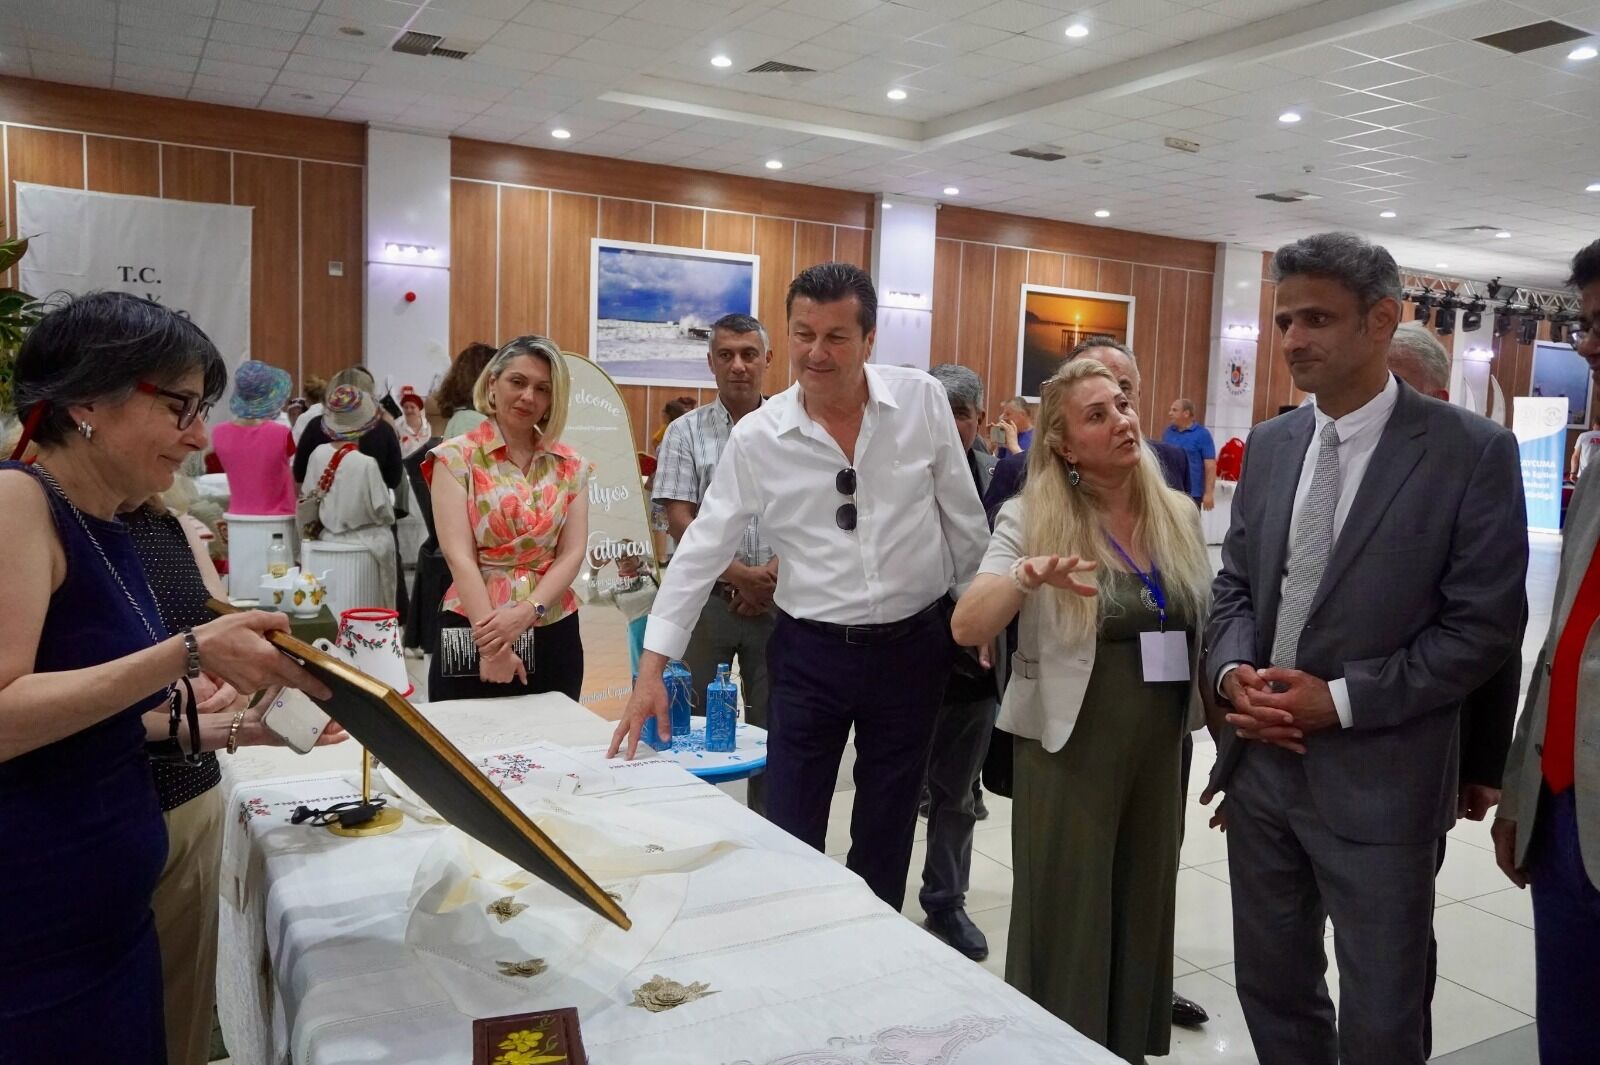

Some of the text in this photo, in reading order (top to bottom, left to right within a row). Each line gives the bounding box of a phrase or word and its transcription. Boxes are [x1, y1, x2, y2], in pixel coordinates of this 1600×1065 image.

[117, 266, 162, 284] T.C.
[571, 387, 620, 417] elcome
[587, 475, 629, 512] ilyos
